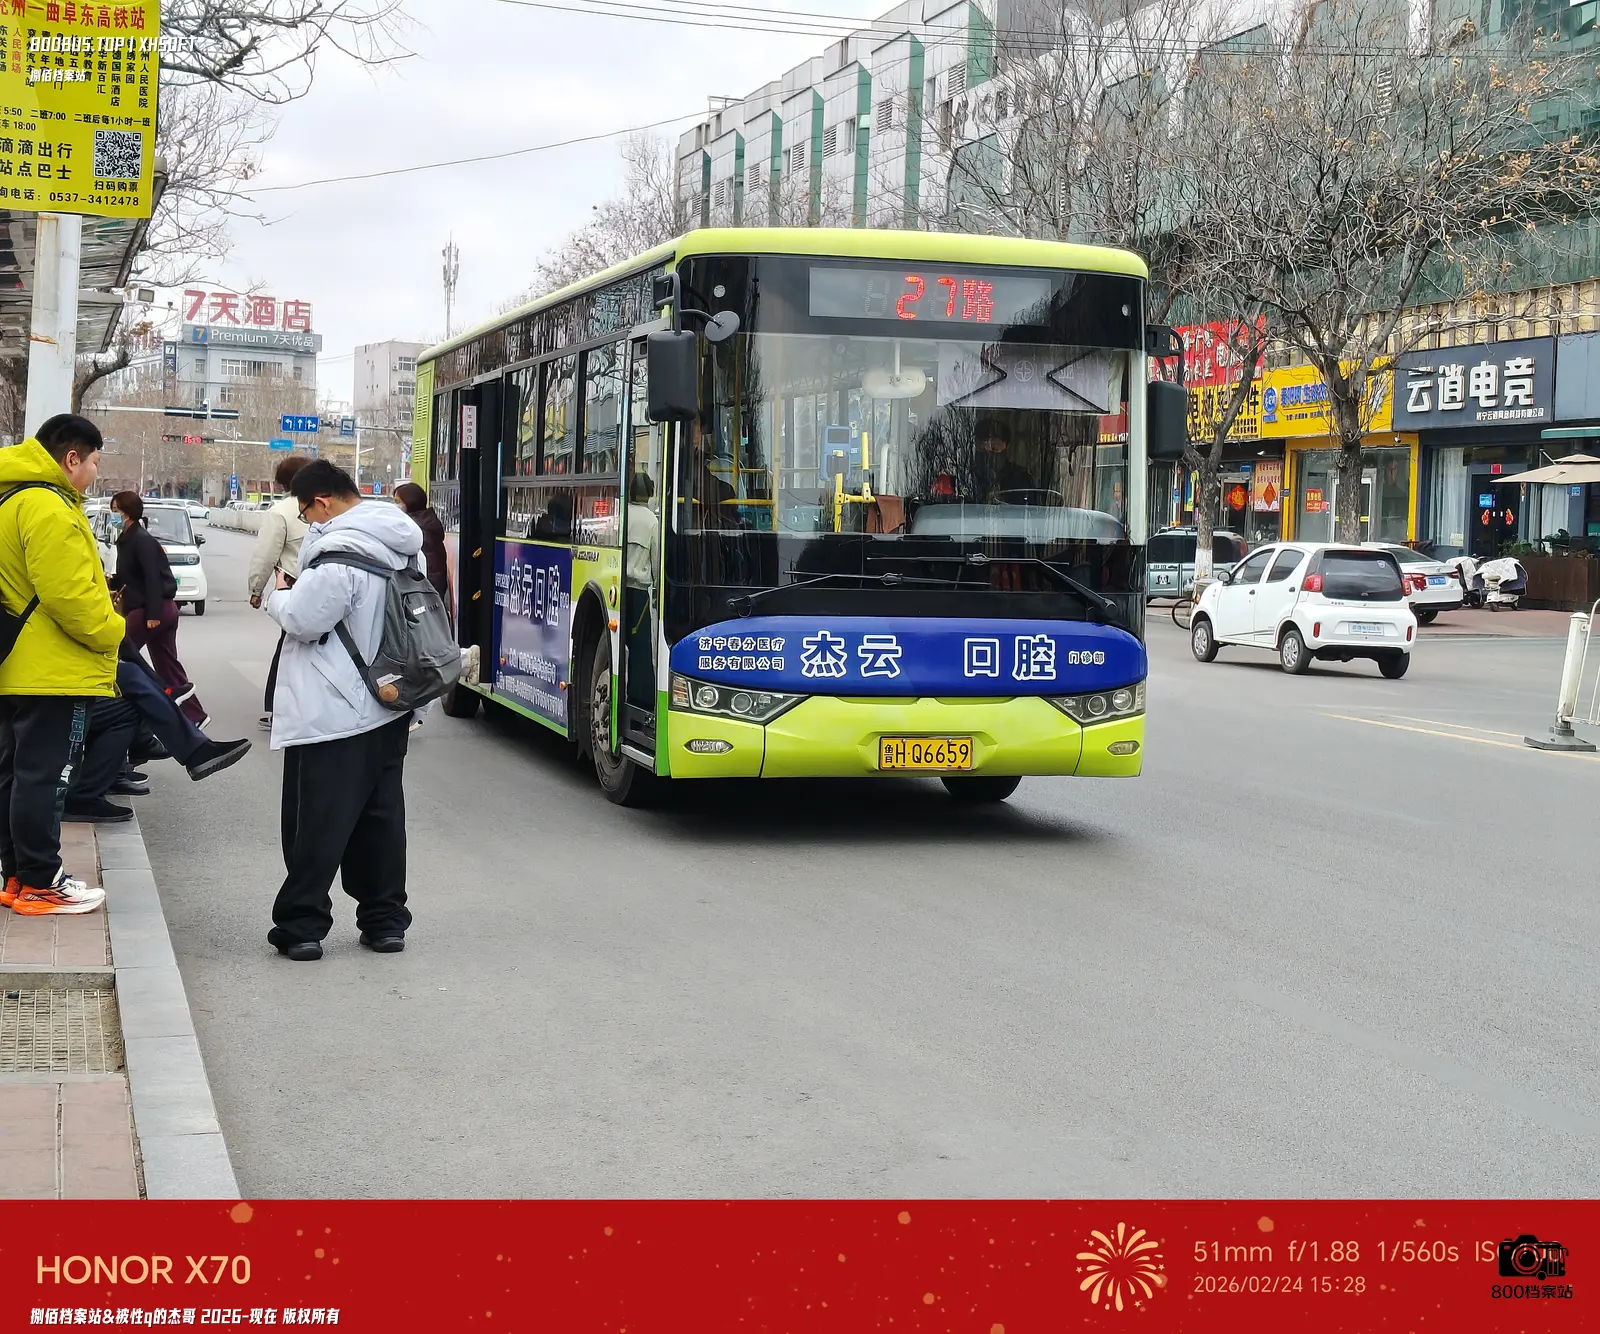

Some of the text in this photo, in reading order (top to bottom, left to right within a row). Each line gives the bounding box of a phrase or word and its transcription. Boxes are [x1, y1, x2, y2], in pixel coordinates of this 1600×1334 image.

[12, 28, 22, 74] 人民商场
[4, 106, 22, 117] 5:50
[13, 121, 36, 131] 18:00
[0, 136, 73, 160] 滴滴出行
[0, 158, 72, 180] 站点巴士
[94, 180, 138, 193] 扫码购票
[49, 192, 139, 206] 0537-3412478
[896, 275, 994, 323] 27路
[184, 289, 312, 332] 7天酒店
[211, 329, 268, 344] Premium
[272, 334, 314, 347] 7天优品
[1406, 356, 1536, 414] 云逍电竞
[698, 636, 785, 651] 济宁春分医疗
[698, 656, 785, 671] 服务有限公司
[800, 630, 1105, 681] 杰云 口腔 门诊部
